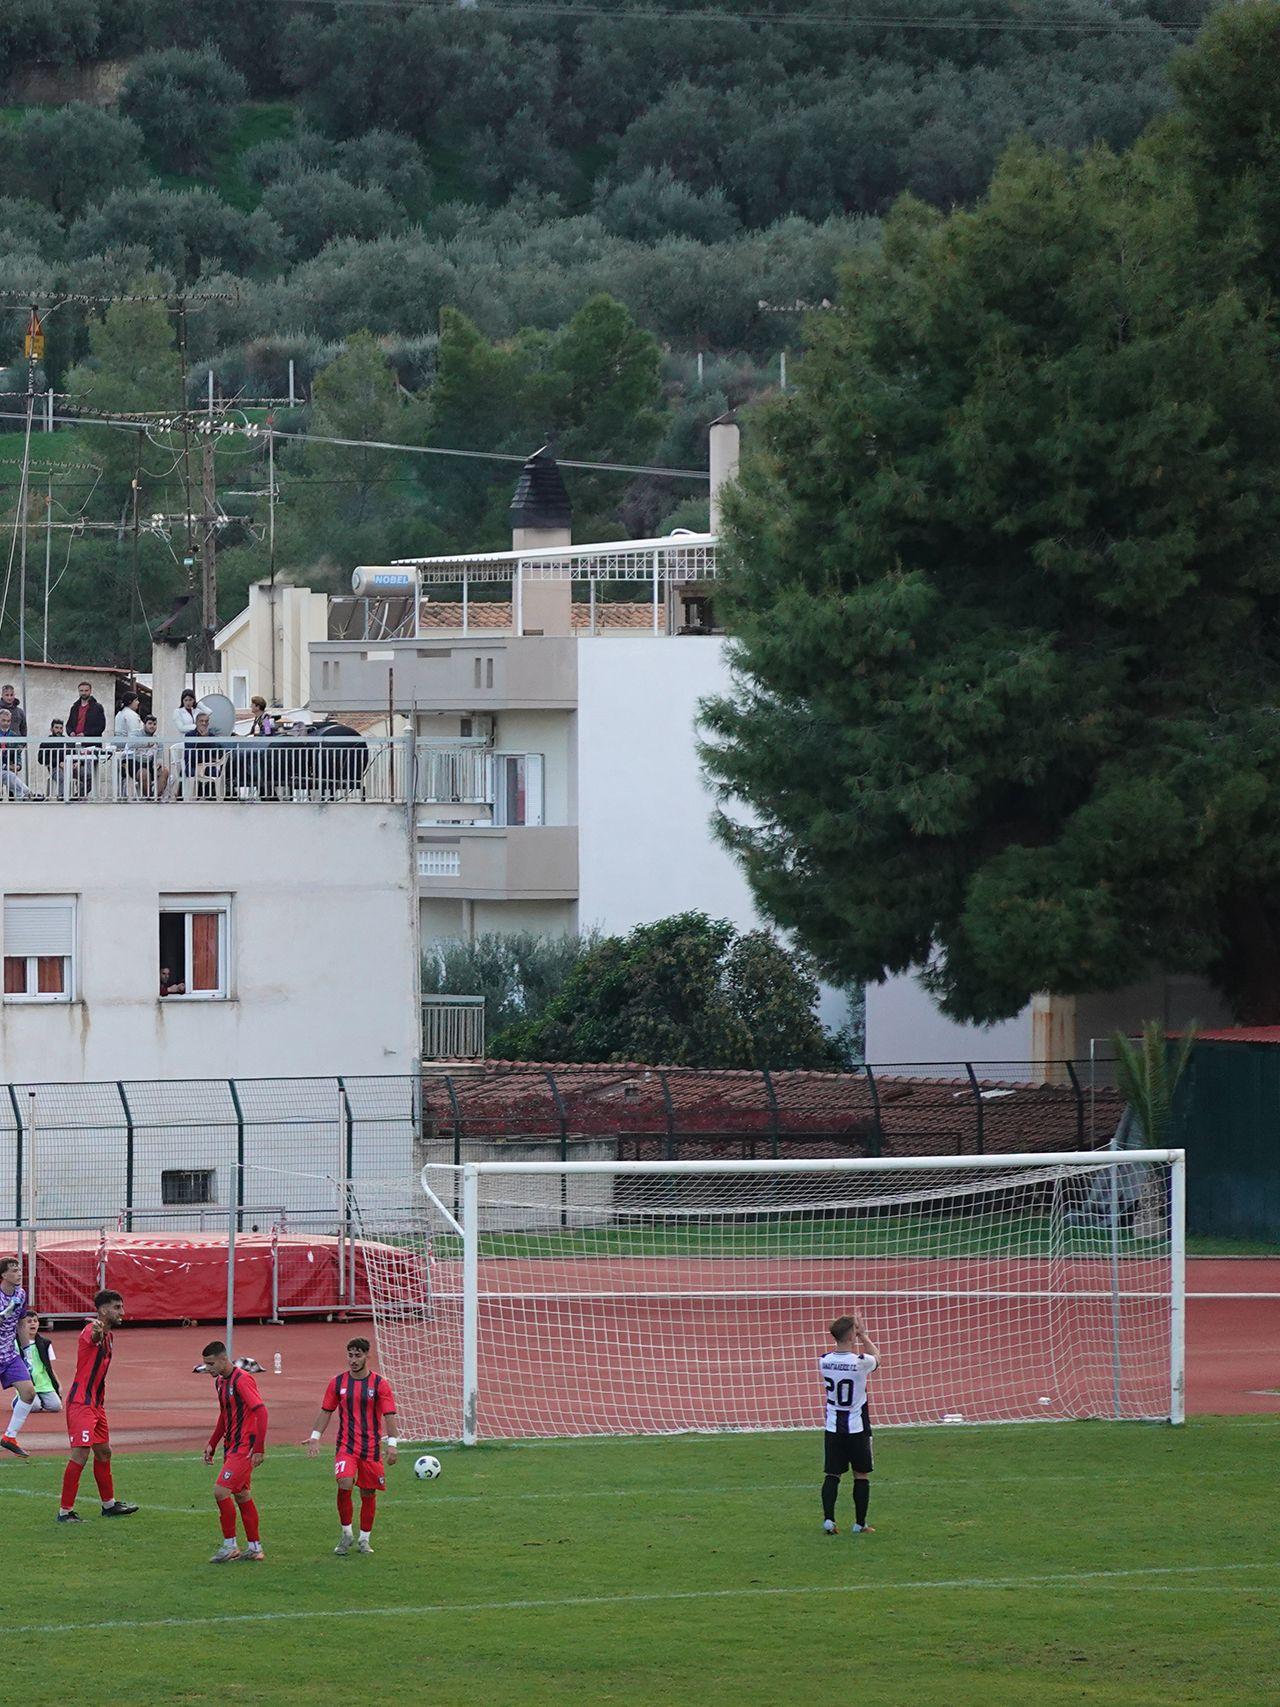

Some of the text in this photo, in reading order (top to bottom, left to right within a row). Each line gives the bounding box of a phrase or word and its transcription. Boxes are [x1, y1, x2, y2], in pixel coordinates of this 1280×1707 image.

[375, 575, 408, 584] NOBEL
[824, 1377, 854, 1406] 20
[82, 1430, 90, 1442] 5
